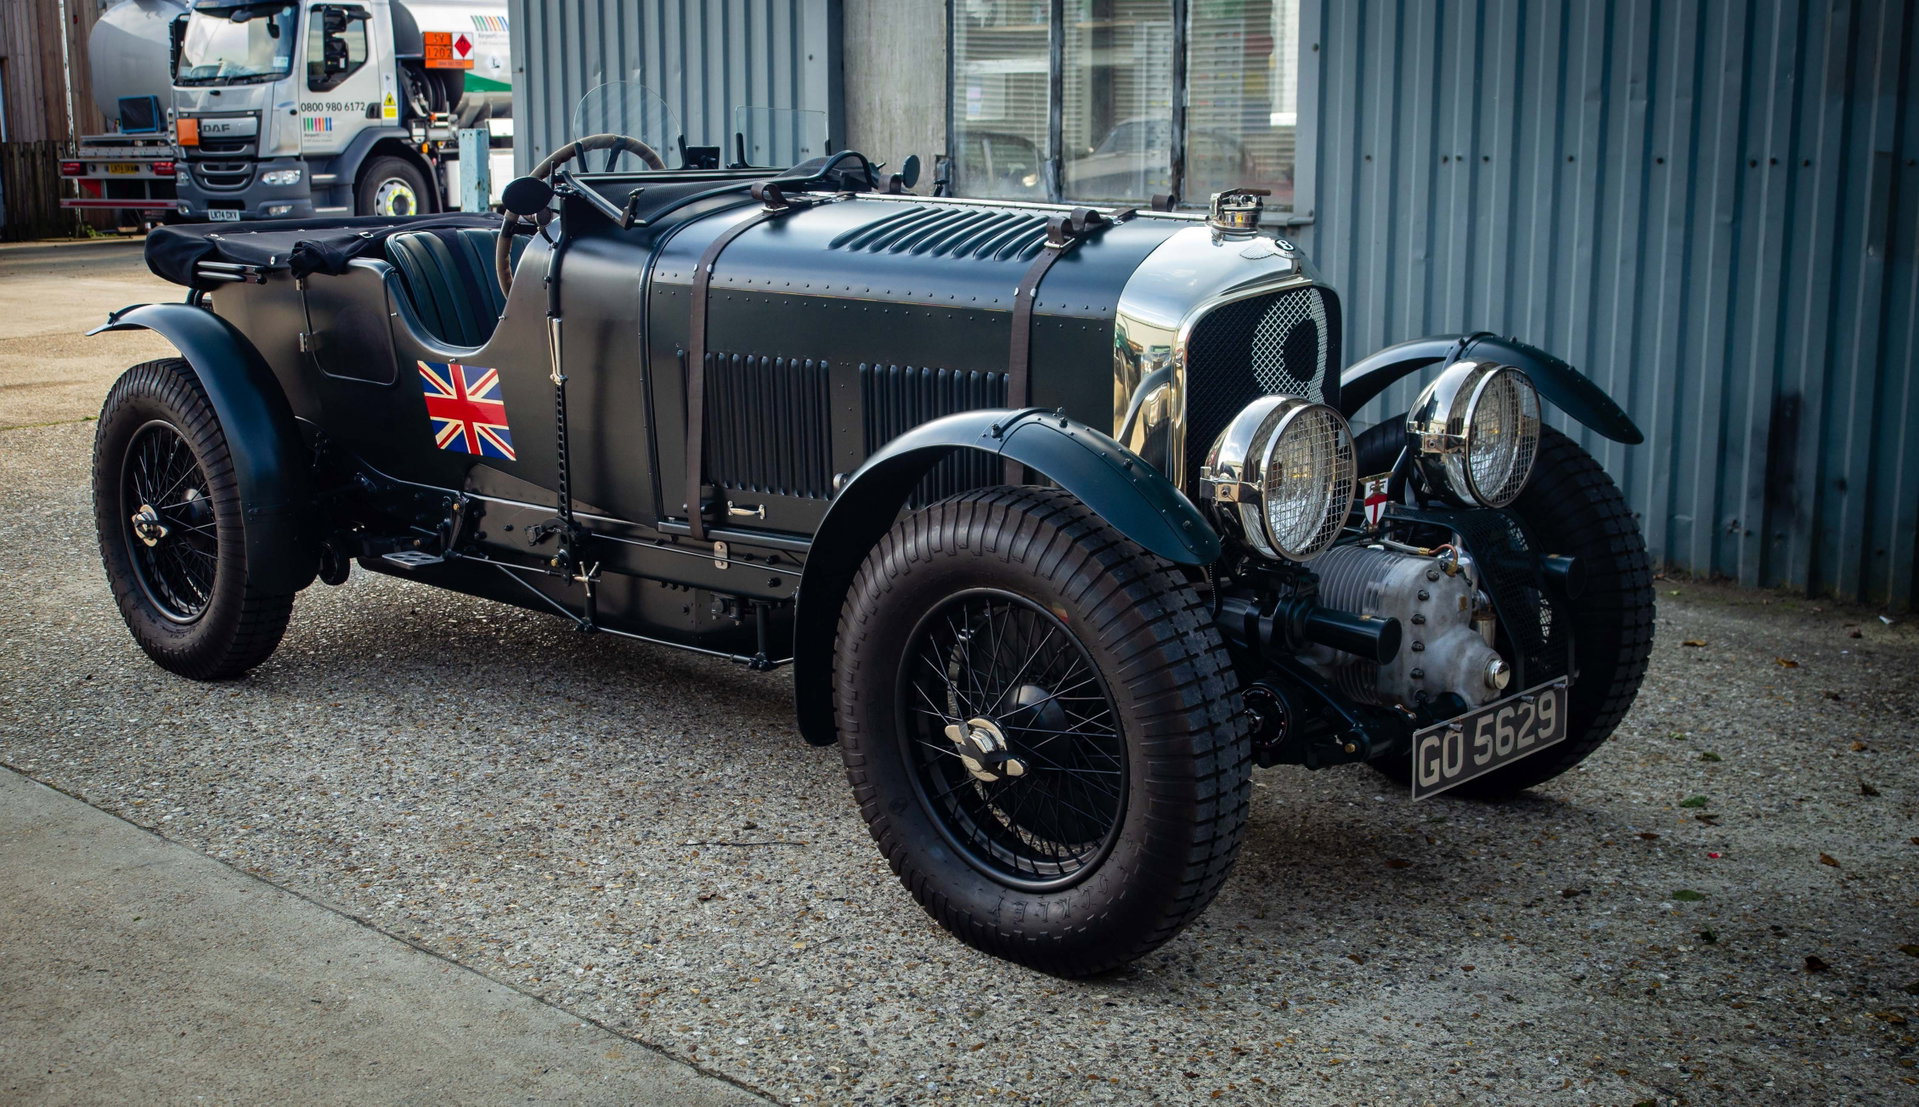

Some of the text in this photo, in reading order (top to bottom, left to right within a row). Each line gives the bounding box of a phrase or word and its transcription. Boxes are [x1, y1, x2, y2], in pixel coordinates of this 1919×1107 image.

[427, 47, 452, 58] 1202
[300, 101, 366, 112] 0800 980 6172
[203, 123, 230, 133] DAF
[1276, 239, 1295, 250] B
[1418, 690, 1556, 788] GO 5629
